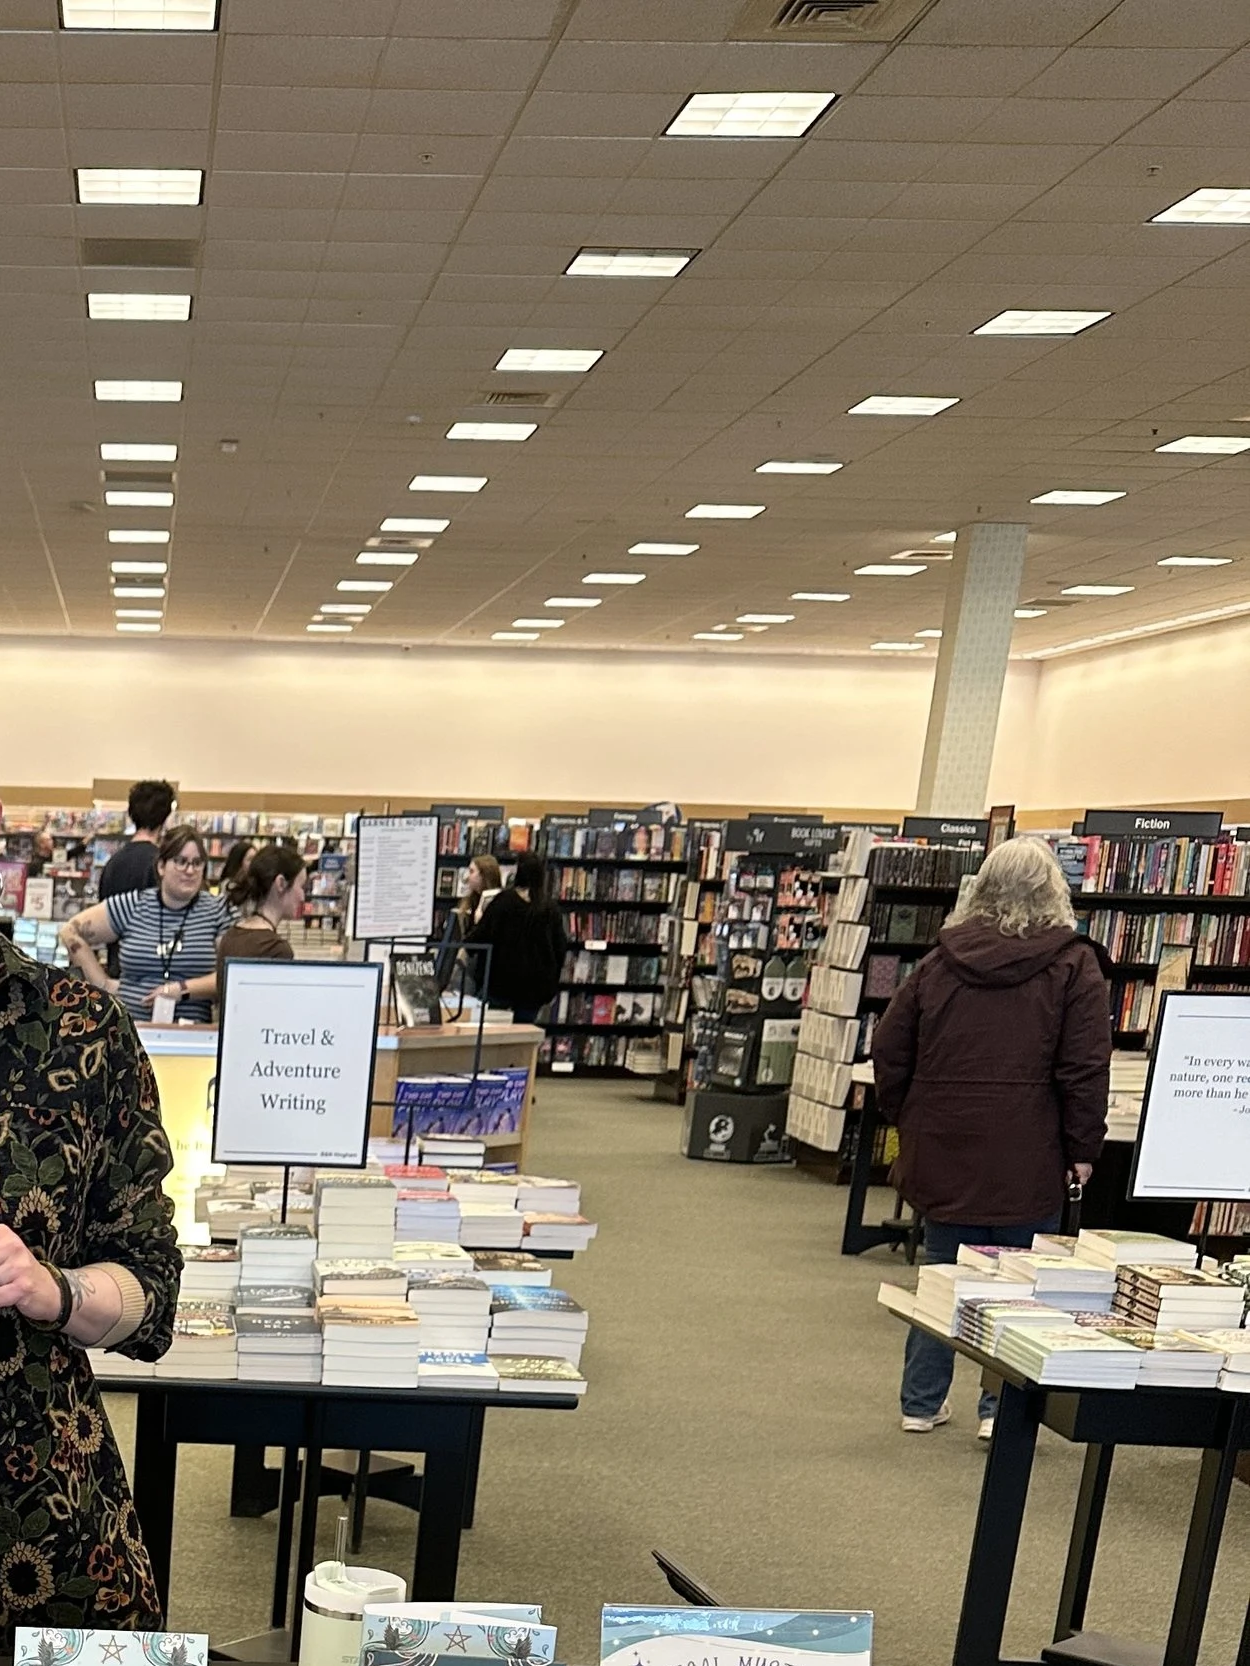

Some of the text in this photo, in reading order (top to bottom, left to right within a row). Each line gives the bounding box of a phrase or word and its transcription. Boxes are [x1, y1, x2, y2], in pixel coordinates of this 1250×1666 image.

[362, 818, 396, 827] BARNES
[406, 818, 434, 827] NOBLE
[1135, 817, 1171, 830] Fiction
[791, 827, 810, 839] BOOK
[940, 823, 977, 835] Classics
[396, 961, 435, 977] DENIZENS
[261, 1028, 335, 1046] Travel &
[250, 1060, 341, 1079] Adventure
[1204, 1059, 1235, 1069] every
[1237, 1059, 1250, 1067] wa
[1169, 1072, 1209, 1084] nature,
[1212, 1074, 1233, 1083] one
[1174, 1087, 1248, 1099] more than he
[260, 1093, 327, 1115] Writing
